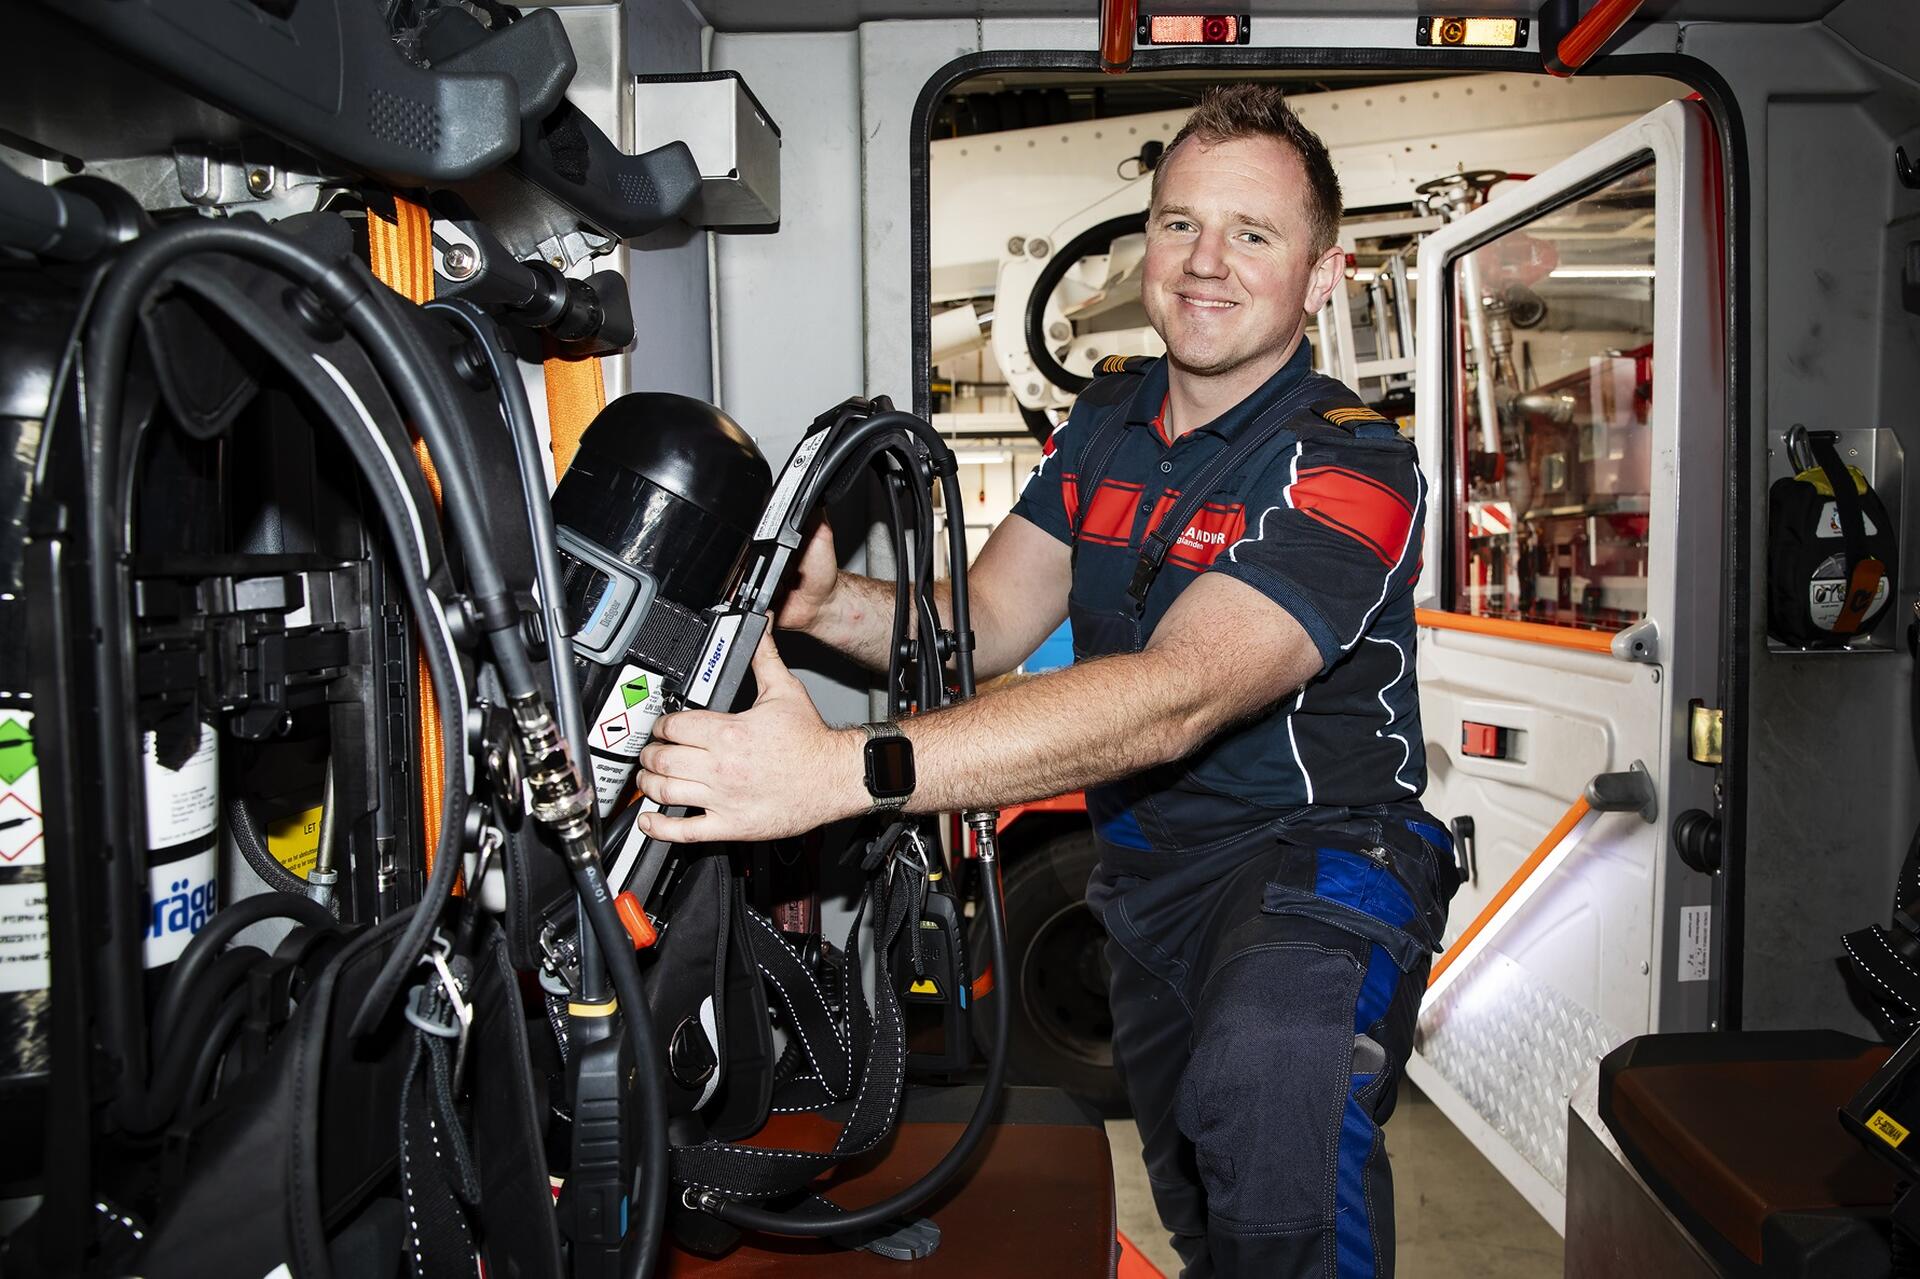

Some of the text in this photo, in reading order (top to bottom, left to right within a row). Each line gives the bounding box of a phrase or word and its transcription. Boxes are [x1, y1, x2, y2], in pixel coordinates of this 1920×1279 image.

[702, 637, 725, 682] Dräger
[303, 822, 316, 835] LET
[144, 878, 216, 938] räge
